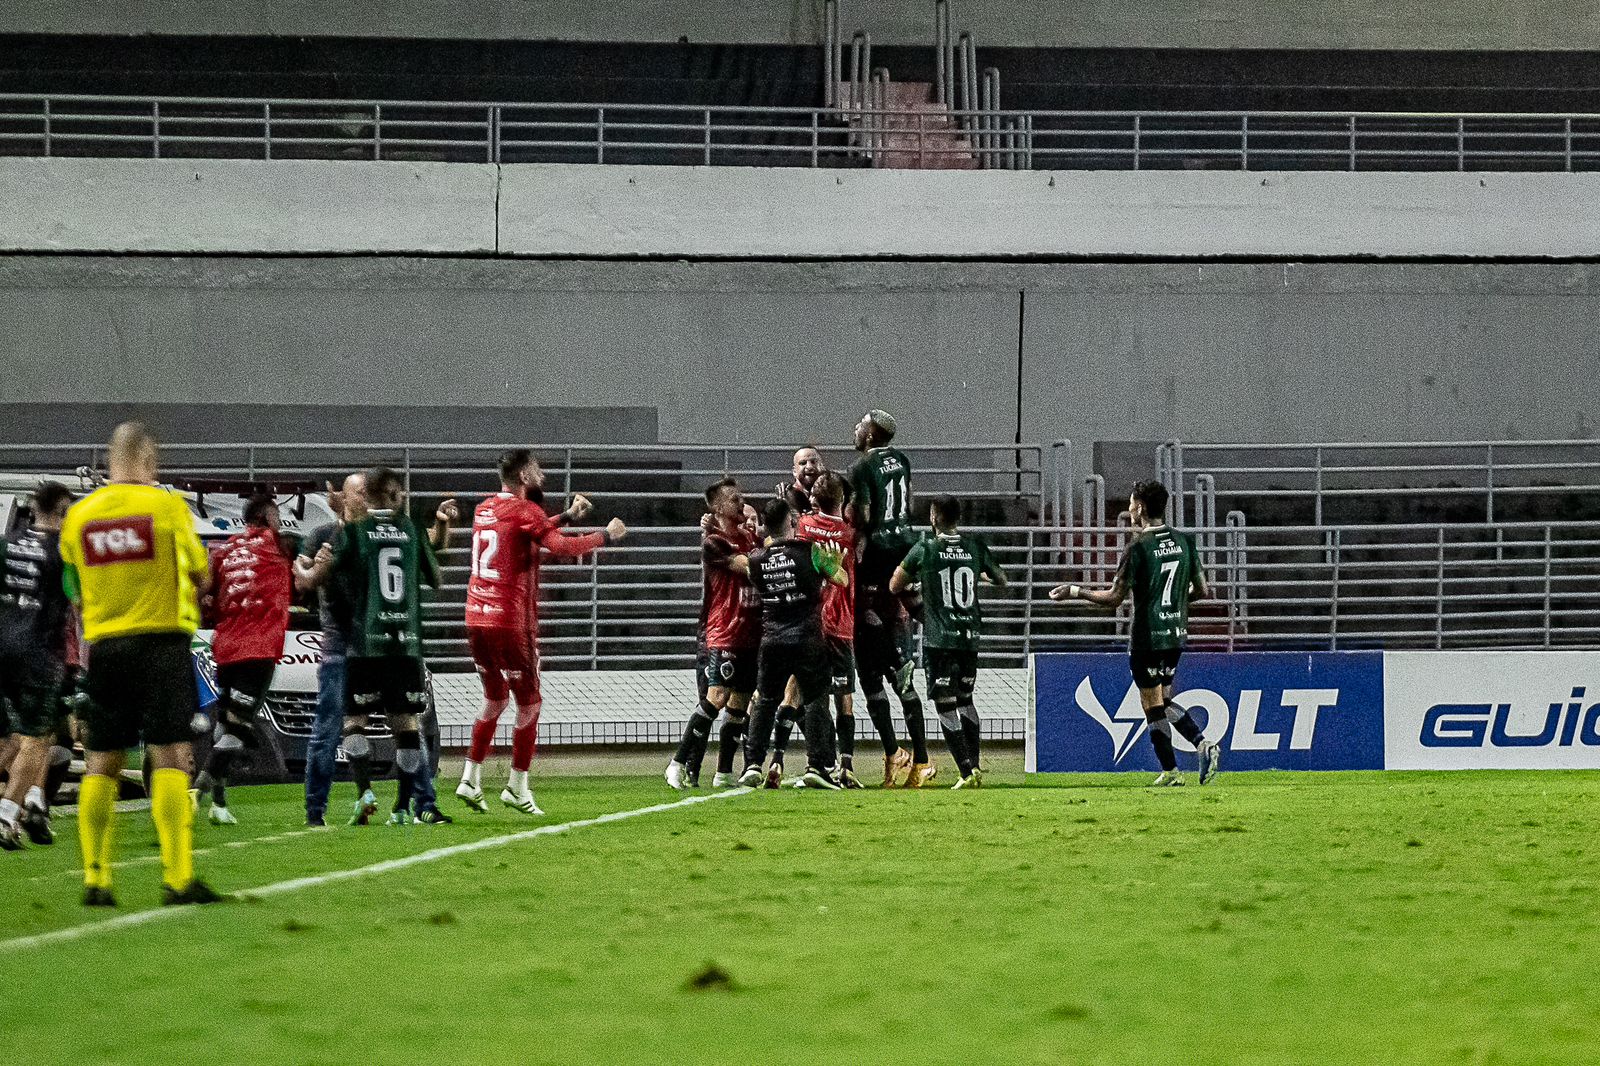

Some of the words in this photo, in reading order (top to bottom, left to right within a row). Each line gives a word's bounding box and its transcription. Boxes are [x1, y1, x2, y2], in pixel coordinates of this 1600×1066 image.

[884, 475, 907, 520] 11
[87, 527, 148, 557] TCL
[471, 529, 501, 579] 12
[378, 546, 404, 603] 6
[938, 566, 974, 609] 10
[1160, 560, 1180, 606] 7
[1074, 675, 1340, 766] VOLT
[1419, 686, 1600, 748] GUi
